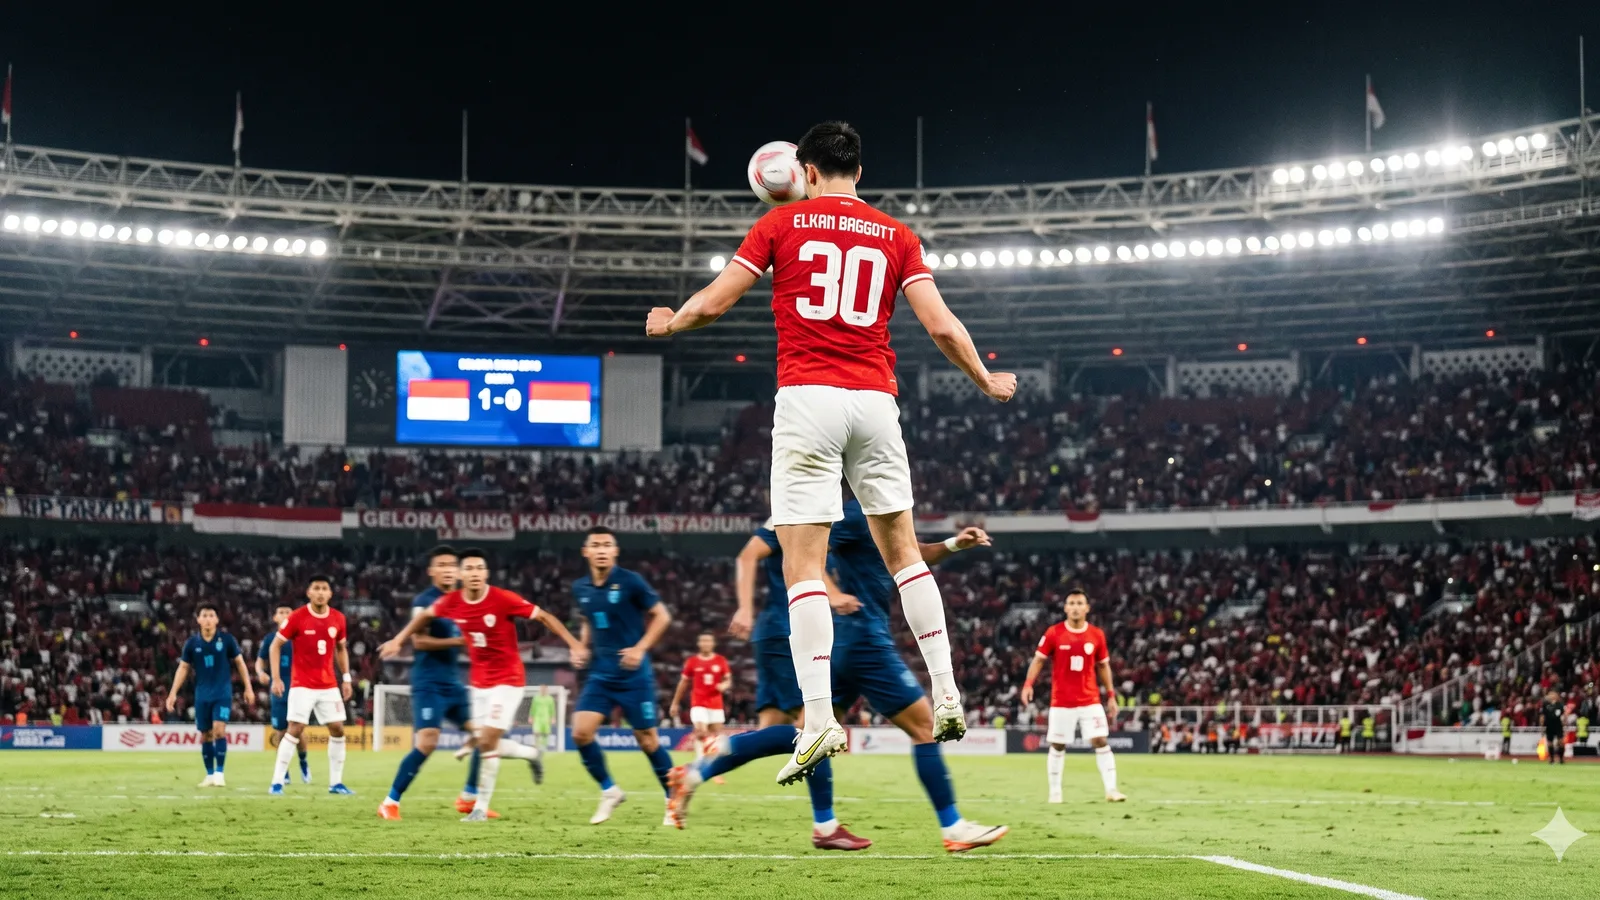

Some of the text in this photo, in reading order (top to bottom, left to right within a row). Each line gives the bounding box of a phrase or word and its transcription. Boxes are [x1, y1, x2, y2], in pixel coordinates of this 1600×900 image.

[793, 213, 896, 241] ELKAN BAGGOTT
[795, 240, 888, 327] 30
[363, 510, 449, 528] GELORA
[453, 512, 514, 530] BUNG
[519, 513, 592, 532] KARNO
